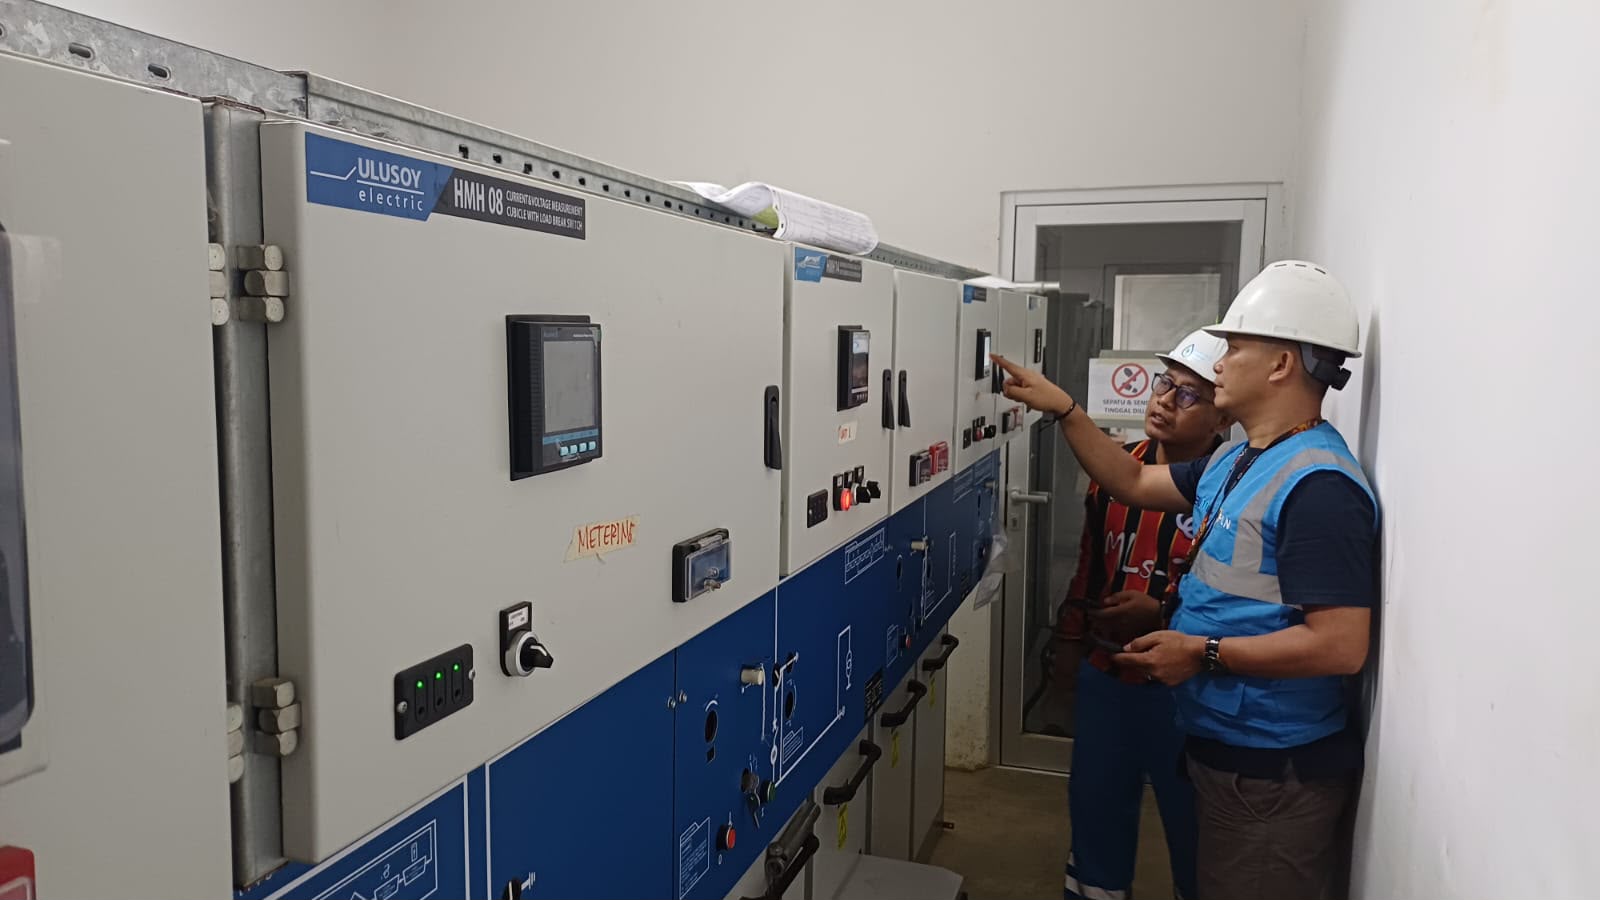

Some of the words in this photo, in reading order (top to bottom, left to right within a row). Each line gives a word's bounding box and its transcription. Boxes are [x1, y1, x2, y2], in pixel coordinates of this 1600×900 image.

[357, 157, 422, 189] ULUSOY
[358, 186, 424, 212] electric
[453, 177, 485, 213] HMH
[488, 187, 504, 216] 08
[506, 206, 527, 220] CUBICLE
[526, 210, 540, 222] WITH
[539, 213, 553, 225] LOAD
